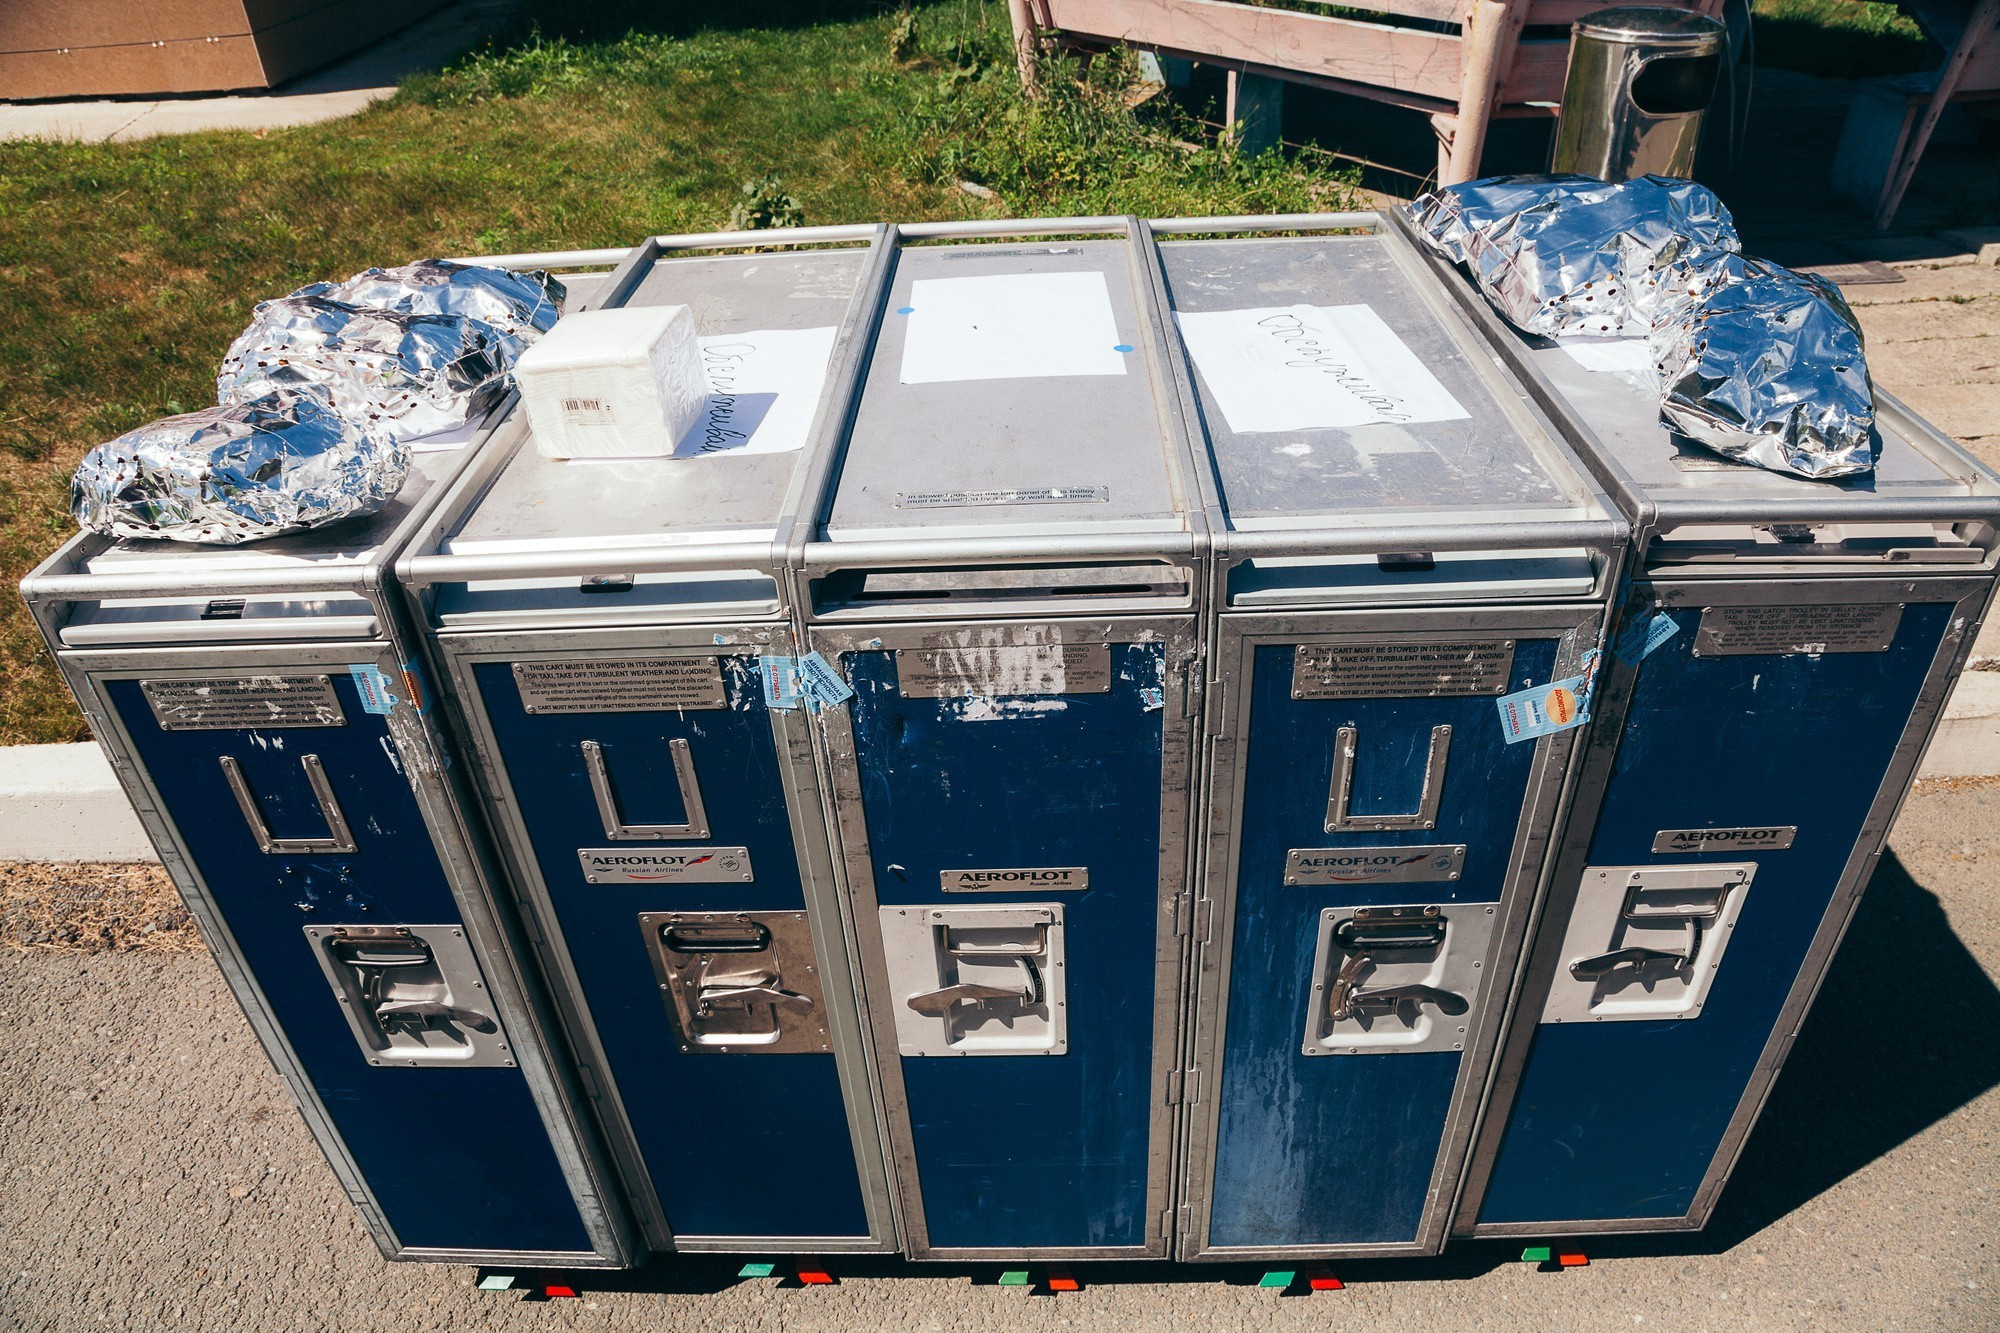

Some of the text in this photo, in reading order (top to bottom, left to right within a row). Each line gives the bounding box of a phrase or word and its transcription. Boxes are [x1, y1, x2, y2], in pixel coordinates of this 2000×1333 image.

[662, 678, 680, 686] weight
[808, 659, 843, 696] АВИАЦИОННАЯ
[772, 673, 780, 700] ОТРЫВАТЬ
[628, 693, 662, 701] compartment
[1554, 689, 1568, 723] ДОСМОТРЕНО
[1510, 710, 1520, 735] ОТРЫВАТЬ
[1672, 830, 1782, 842] AEROFLOT
[592, 856, 686, 865] AEROFLOT
[1299, 856, 1400, 867] AEROFLOT
[959, 871, 1072, 882] AEROFLOT
